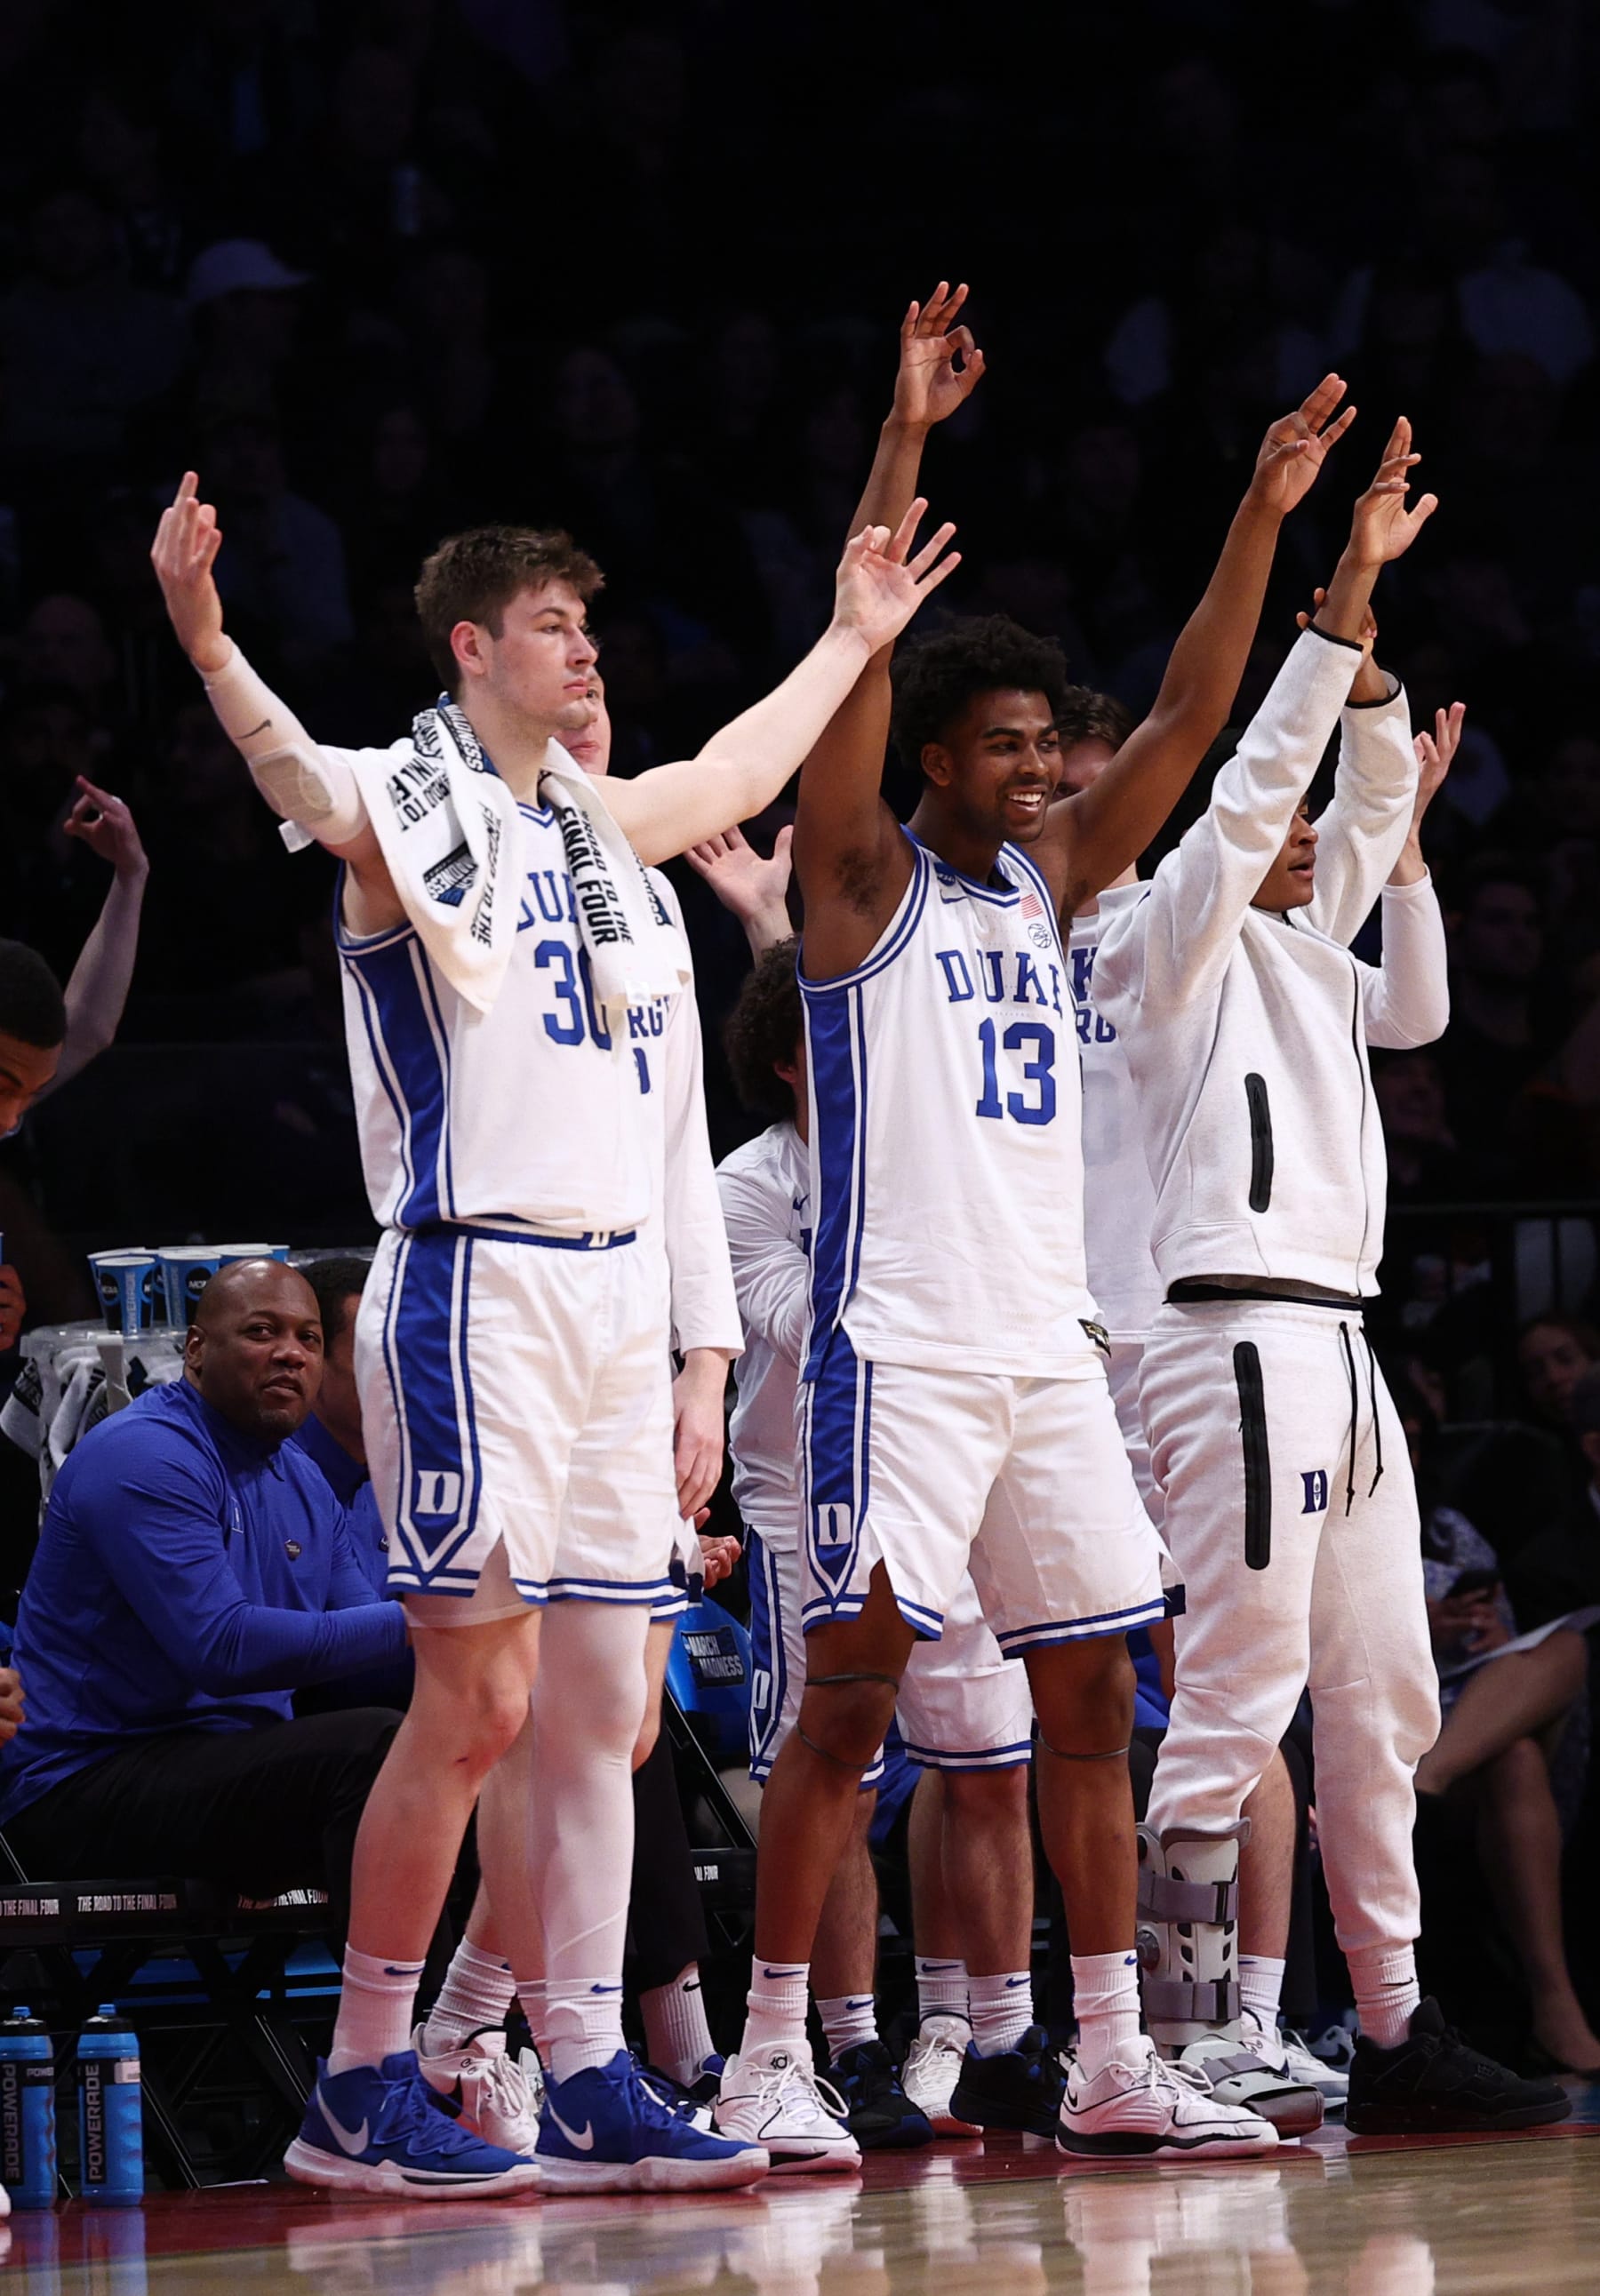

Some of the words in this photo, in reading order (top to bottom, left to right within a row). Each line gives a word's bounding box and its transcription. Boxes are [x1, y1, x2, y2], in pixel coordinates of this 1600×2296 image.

[576, 879, 620, 948] FOUR
[603, 879, 619, 902] TO
[613, 910, 635, 946] THE
[976, 1017, 1056, 1125] 13
[415, 1469, 461, 1515] D
[817, 1502, 852, 1546] D
[699, 1655, 744, 1678] MADNESS
[76, 1896, 92, 1912] THE
[2, 2063, 20, 2180] POWERADE
[85, 2063, 104, 2180] POWERADE
